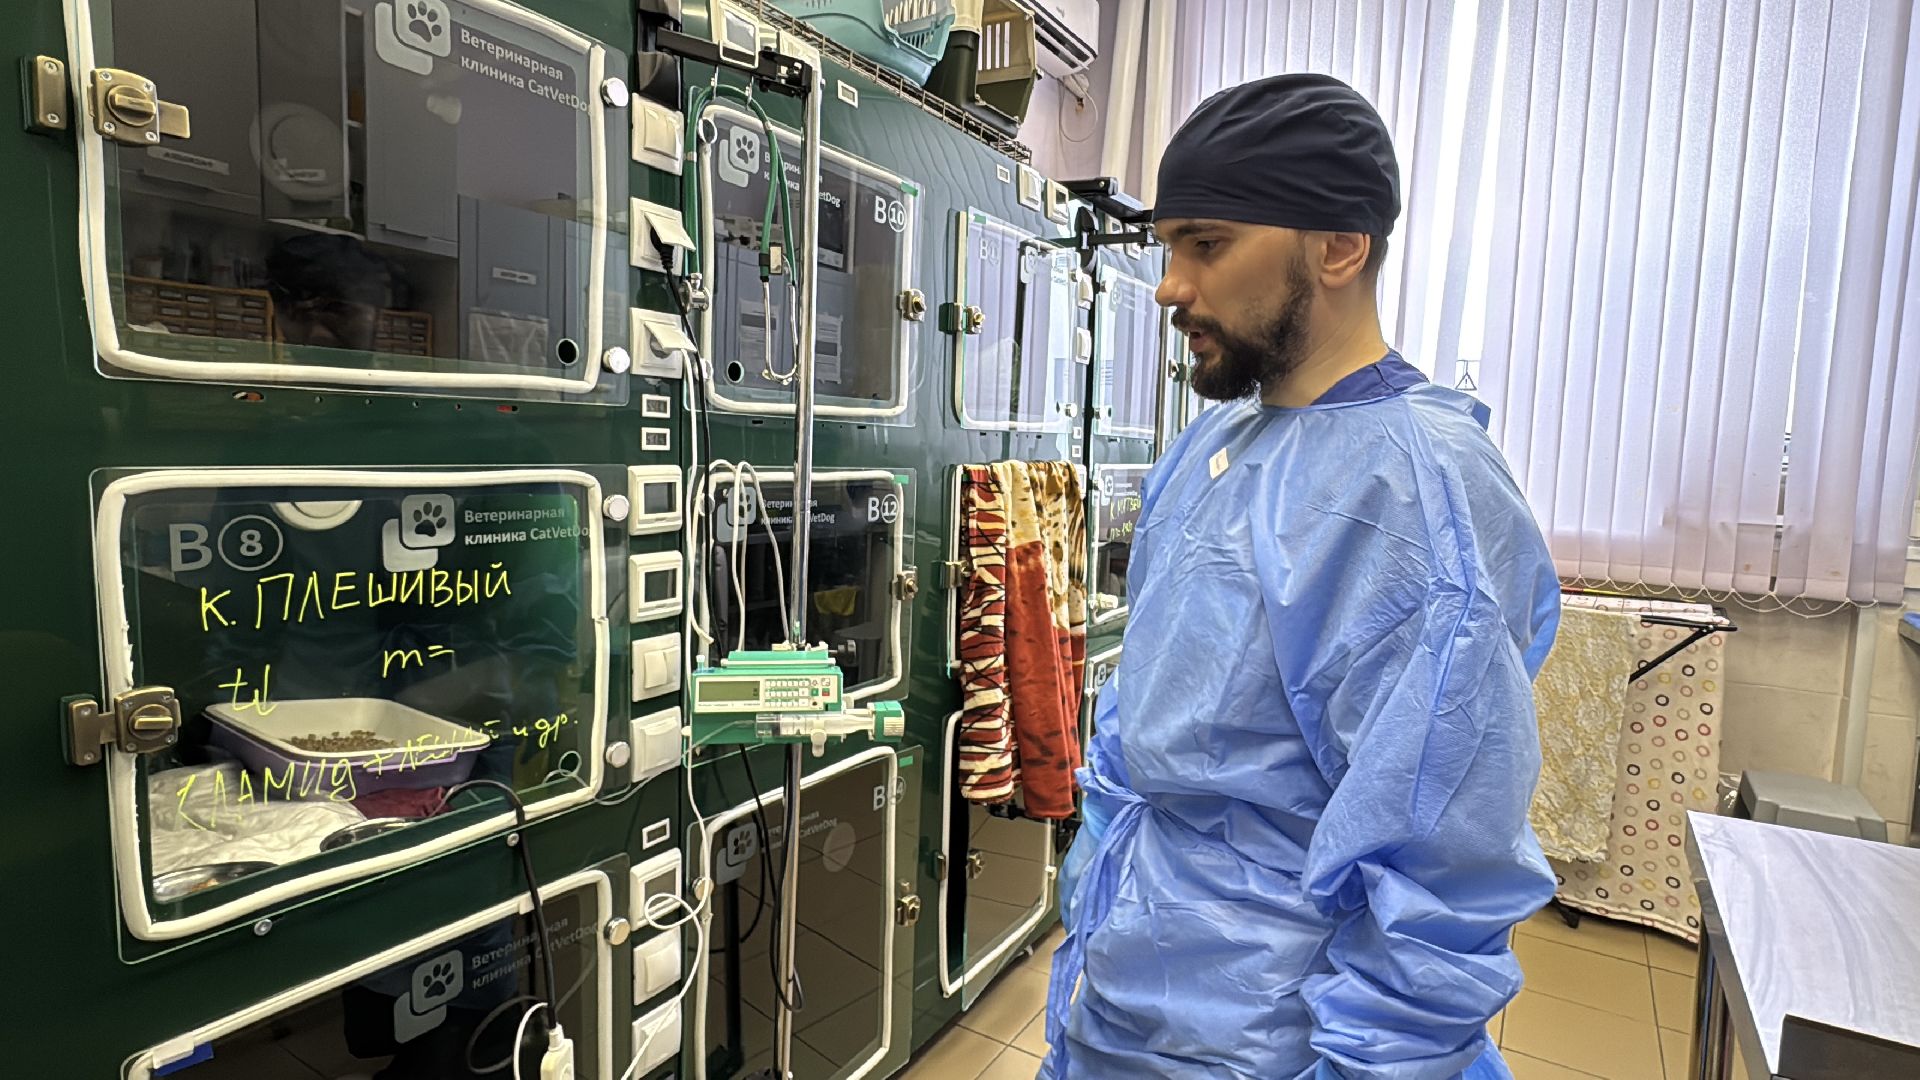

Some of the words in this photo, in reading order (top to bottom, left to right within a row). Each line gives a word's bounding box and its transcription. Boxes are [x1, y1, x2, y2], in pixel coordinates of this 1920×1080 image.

[461, 28, 563, 81] Ветеринарная
[461, 56, 525, 88] клиника
[528, 80, 590, 115] CatVetDo
[464, 508, 565, 524] Ветеринарная
[464, 531, 526, 546] клиника
[256, 561, 512, 630] ПЛЕШИВЫЙ
